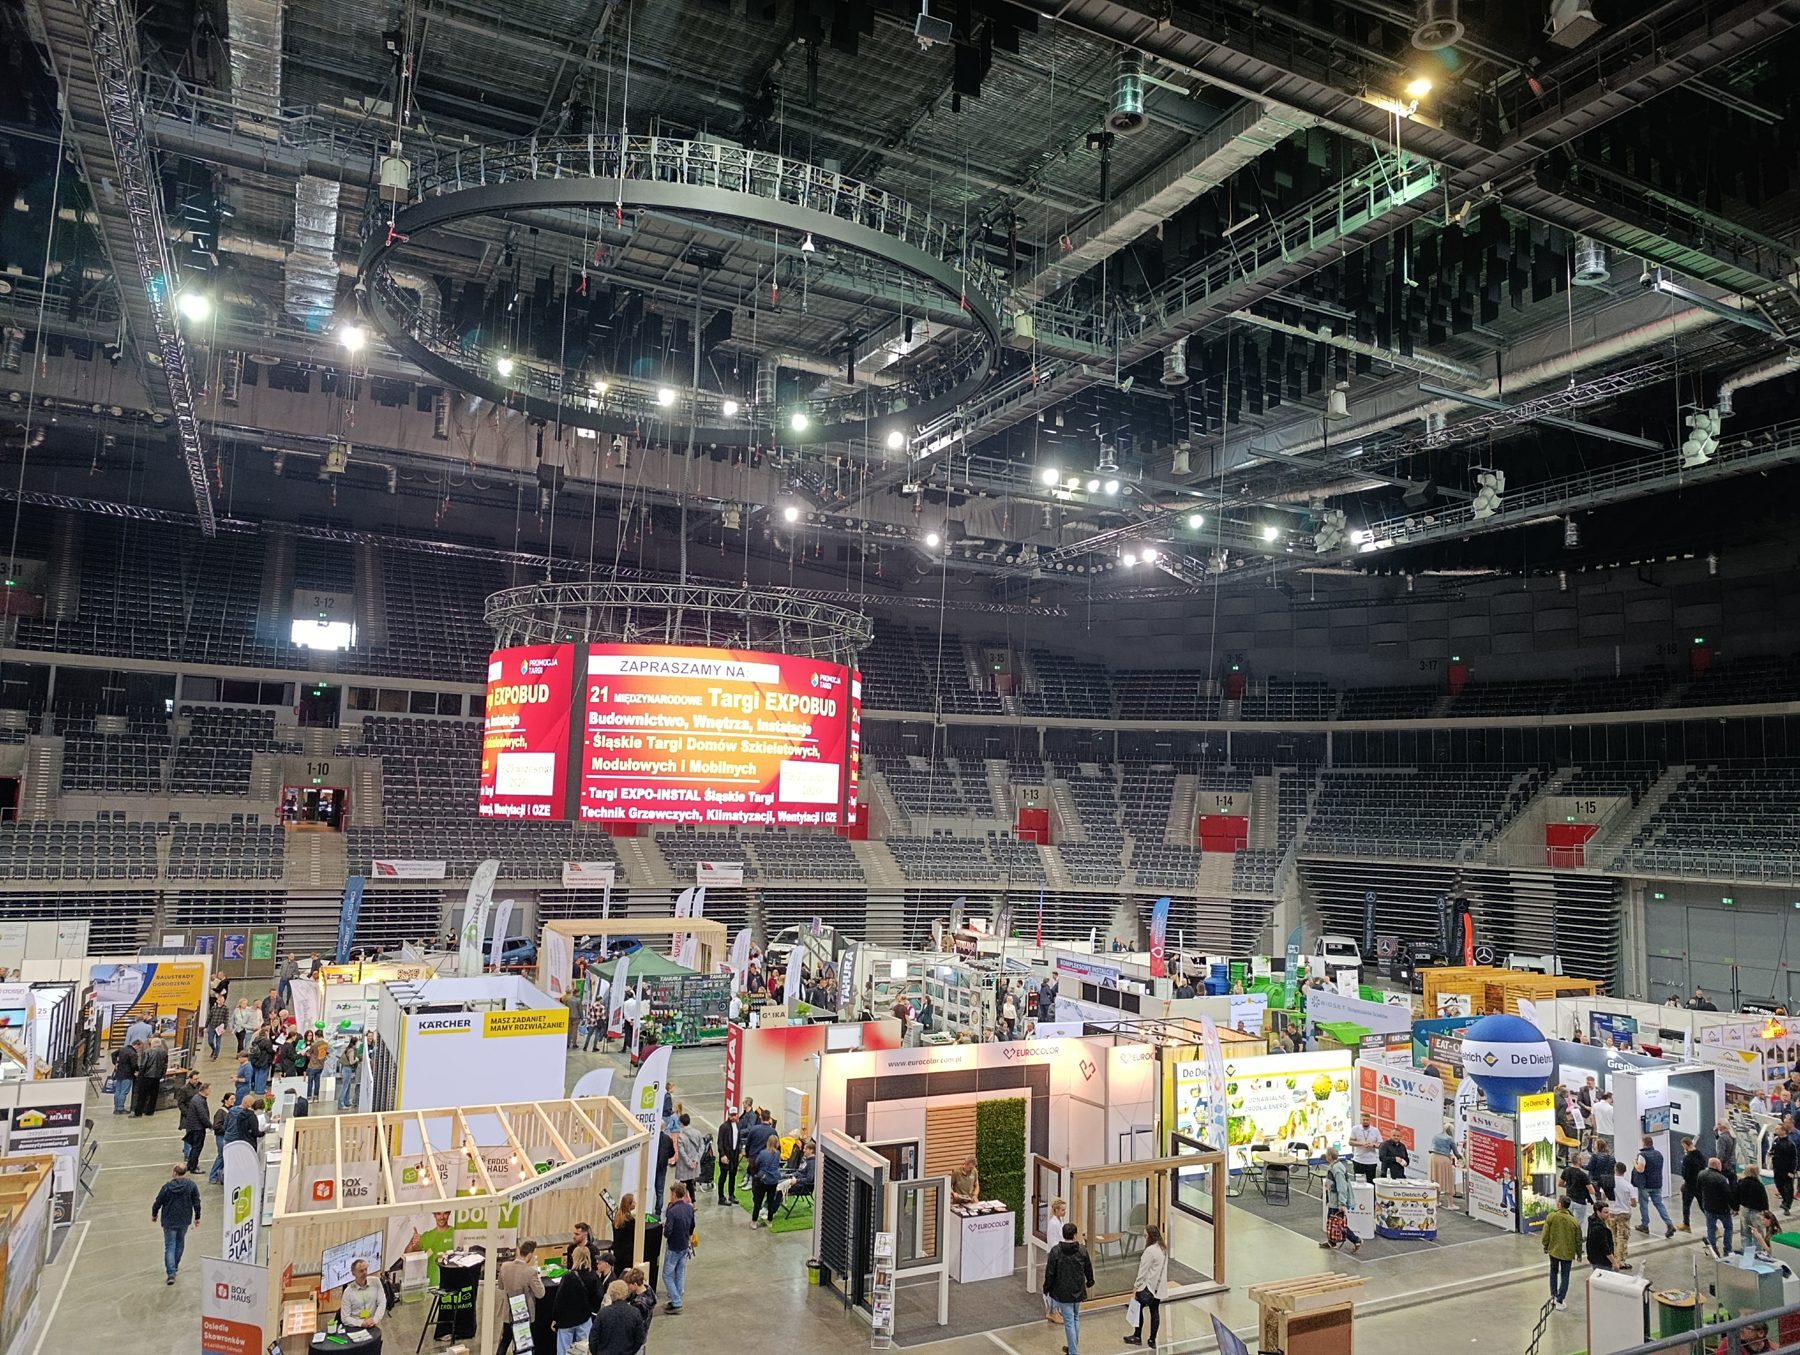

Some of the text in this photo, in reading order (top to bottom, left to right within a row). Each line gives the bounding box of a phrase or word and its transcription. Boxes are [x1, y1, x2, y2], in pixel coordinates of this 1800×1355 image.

[313, 596, 335, 609] 3-12
[620, 660, 722, 676] ZAPRASZAMY
[494, 683, 550, 705] EXPOBUD
[589, 685, 609, 703] 21
[707, 687, 760, 714] Targi
[765, 691, 837, 718] EXPOBUD
[588, 711, 689, 730] Budownictwo,
[693, 714, 754, 733] Wnętrza,
[593, 732, 643, 751] Śląskie
[648, 735, 683, 753] Targi
[687, 736, 738, 752] Domów
[740, 740, 821, 759] Szkieletowych,
[306, 762, 329, 776] 1-10
[591, 756, 757, 777] Modułowych i Mobilnych
[588, 786, 618, 802] Targi
[620, 787, 701, 801] EXPO-INSTAL
[703, 787, 746, 804] Śląskie
[748, 791, 775, 806] Targi
[1022, 788, 1039, 800] 1-13
[1215, 795, 1233, 806] 1-14
[532, 804, 551, 817] OZE
[1575, 800, 1597, 814] 1-15
[580, 805, 626, 818] Technik
[628, 807, 703, 823] Grzewczych,
[706, 809, 776, 824] Klimatyzacji,
[824, 812, 838, 823] OZE
[659, 975, 682, 983] TAHURA
[840, 951, 855, 1006] TAHURA
[418, 1019, 472, 1030] KÄRCHER
[490, 1015, 547, 1025] MASZ ZADANIE?
[490, 1021, 565, 1032] MAMY ROZWIĄZANIE!
[1431, 1037, 1460, 1052] HEAT-O
[1016, 1046, 1059, 1057] EUROCOLOR
[1511, 1054, 1528, 1065] De
[1182, 1067, 1194, 1078] De
[1379, 1074, 1416, 1092] ASW
[1472, 1115, 1493, 1127] ASW
[487, 1158, 509, 1166] ERDOL
[486, 1164, 509, 1174] HAUS
[511, 1183, 543, 1203] PRODUCENT
[610, 1141, 642, 1161] DREWNIANYCH
[977, 1219, 1010, 1231] EUROCOLOR
[231, 1285, 247, 1295] BOX
[230, 1294, 251, 1304] HAUS
[203, 1331, 246, 1346] Skowronków
